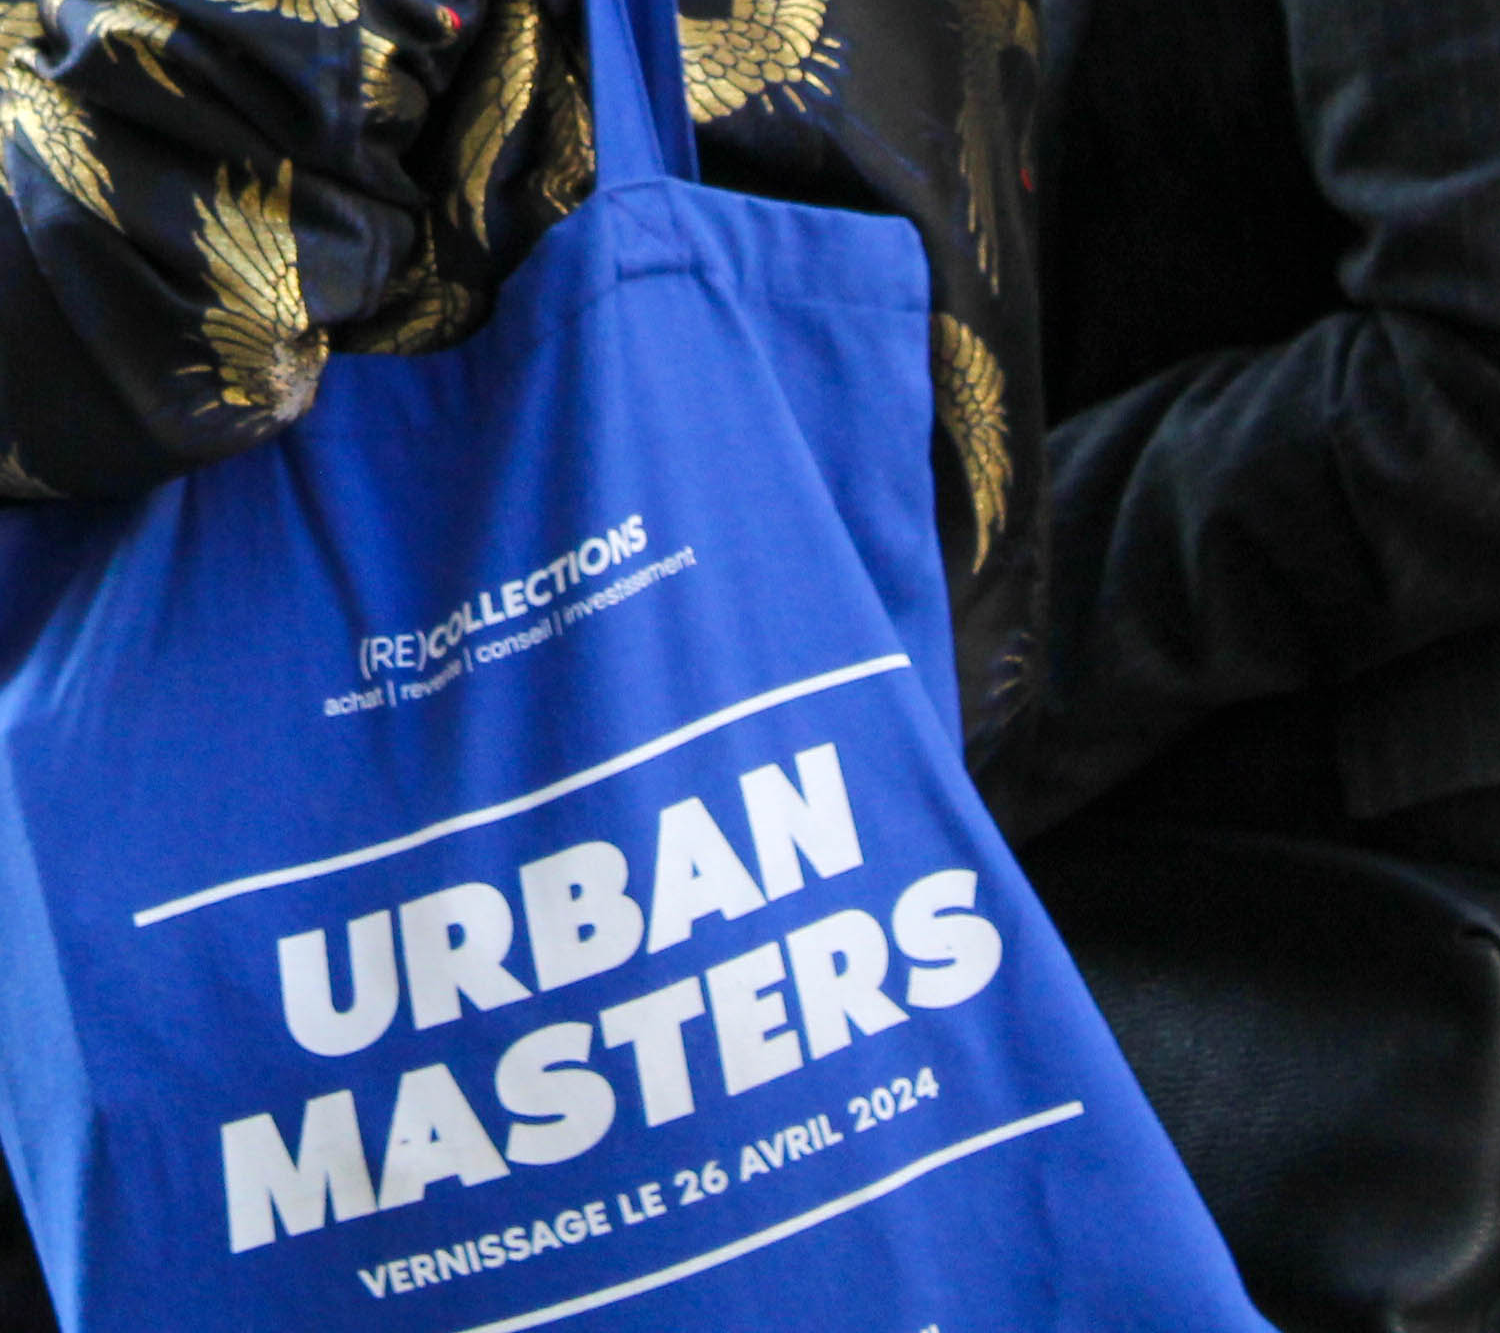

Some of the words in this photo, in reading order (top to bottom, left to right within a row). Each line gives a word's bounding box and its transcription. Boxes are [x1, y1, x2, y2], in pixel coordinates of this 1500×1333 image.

[323, 685, 385, 718] achat
[474, 617, 553, 664] conseil
[562, 545, 698, 625] investissement
[360, 513, 648, 681] (RE)COLLECTIONS
[277, 741, 864, 1058] URBAN
[220, 868, 1003, 1254] MASTERS
[356, 1200, 612, 1299] VERNISSAGE
[617, 1182, 668, 1224] LE
[673, 1160, 730, 1206] 26
[739, 1113, 844, 1182] AVRIL
[848, 1066, 940, 1133] 2024
